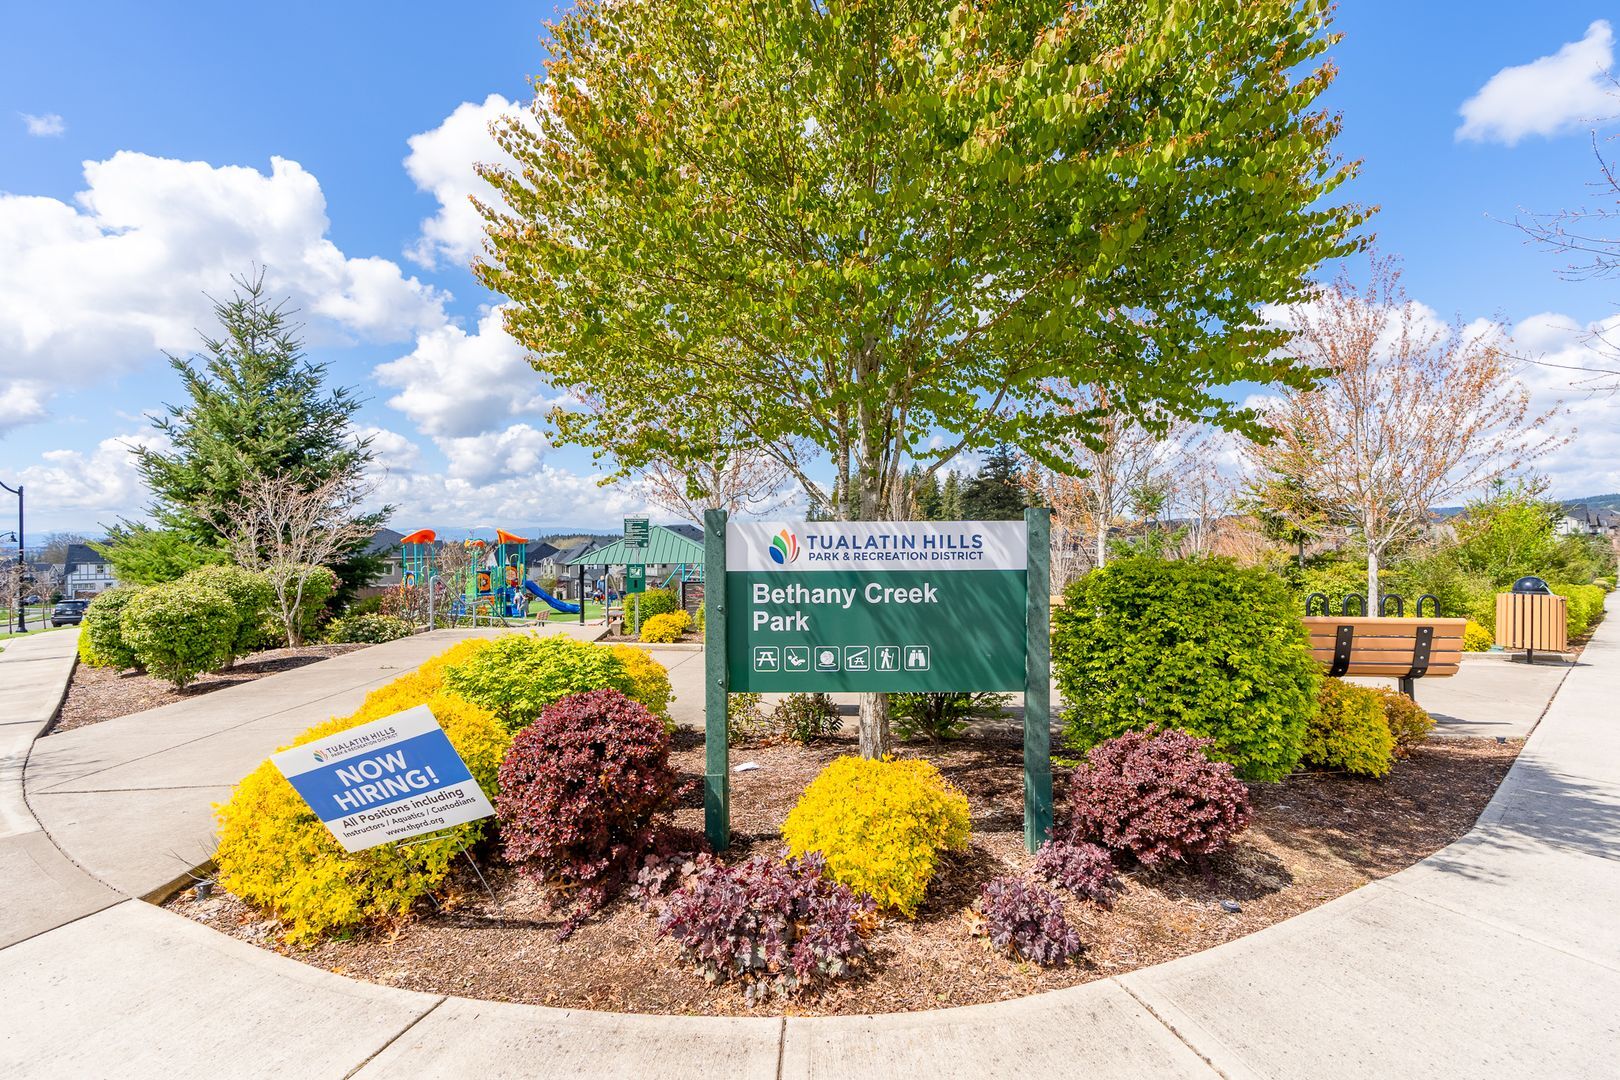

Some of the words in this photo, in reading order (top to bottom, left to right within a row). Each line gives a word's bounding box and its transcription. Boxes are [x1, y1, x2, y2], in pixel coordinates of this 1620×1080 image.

[806, 535, 915, 550] TUALATIN
[923, 534, 983, 549] HILLS
[808, 552, 839, 561] PARK
[842, 552, 851, 561] &
[853, 551, 928, 561] RECREATION
[931, 551, 984, 560] DISTRICT
[753, 583, 857, 609] Bethany
[864, 582, 938, 604] Creek
[753, 611, 810, 632] Park
[326, 735, 370, 754] TUALATIN
[370, 726, 396, 740] HILLS
[335, 749, 408, 787] NOW
[332, 765, 440, 811] HIRING!
[342, 816, 359, 829] All
[358, 803, 411, 824] Positions
[410, 788, 465, 809] including
[342, 822, 386, 838] Instructors
[391, 811, 426, 825] Aquatics
[431, 796, 477, 814] Custodians
[385, 816, 446, 836] www.thprd.org
